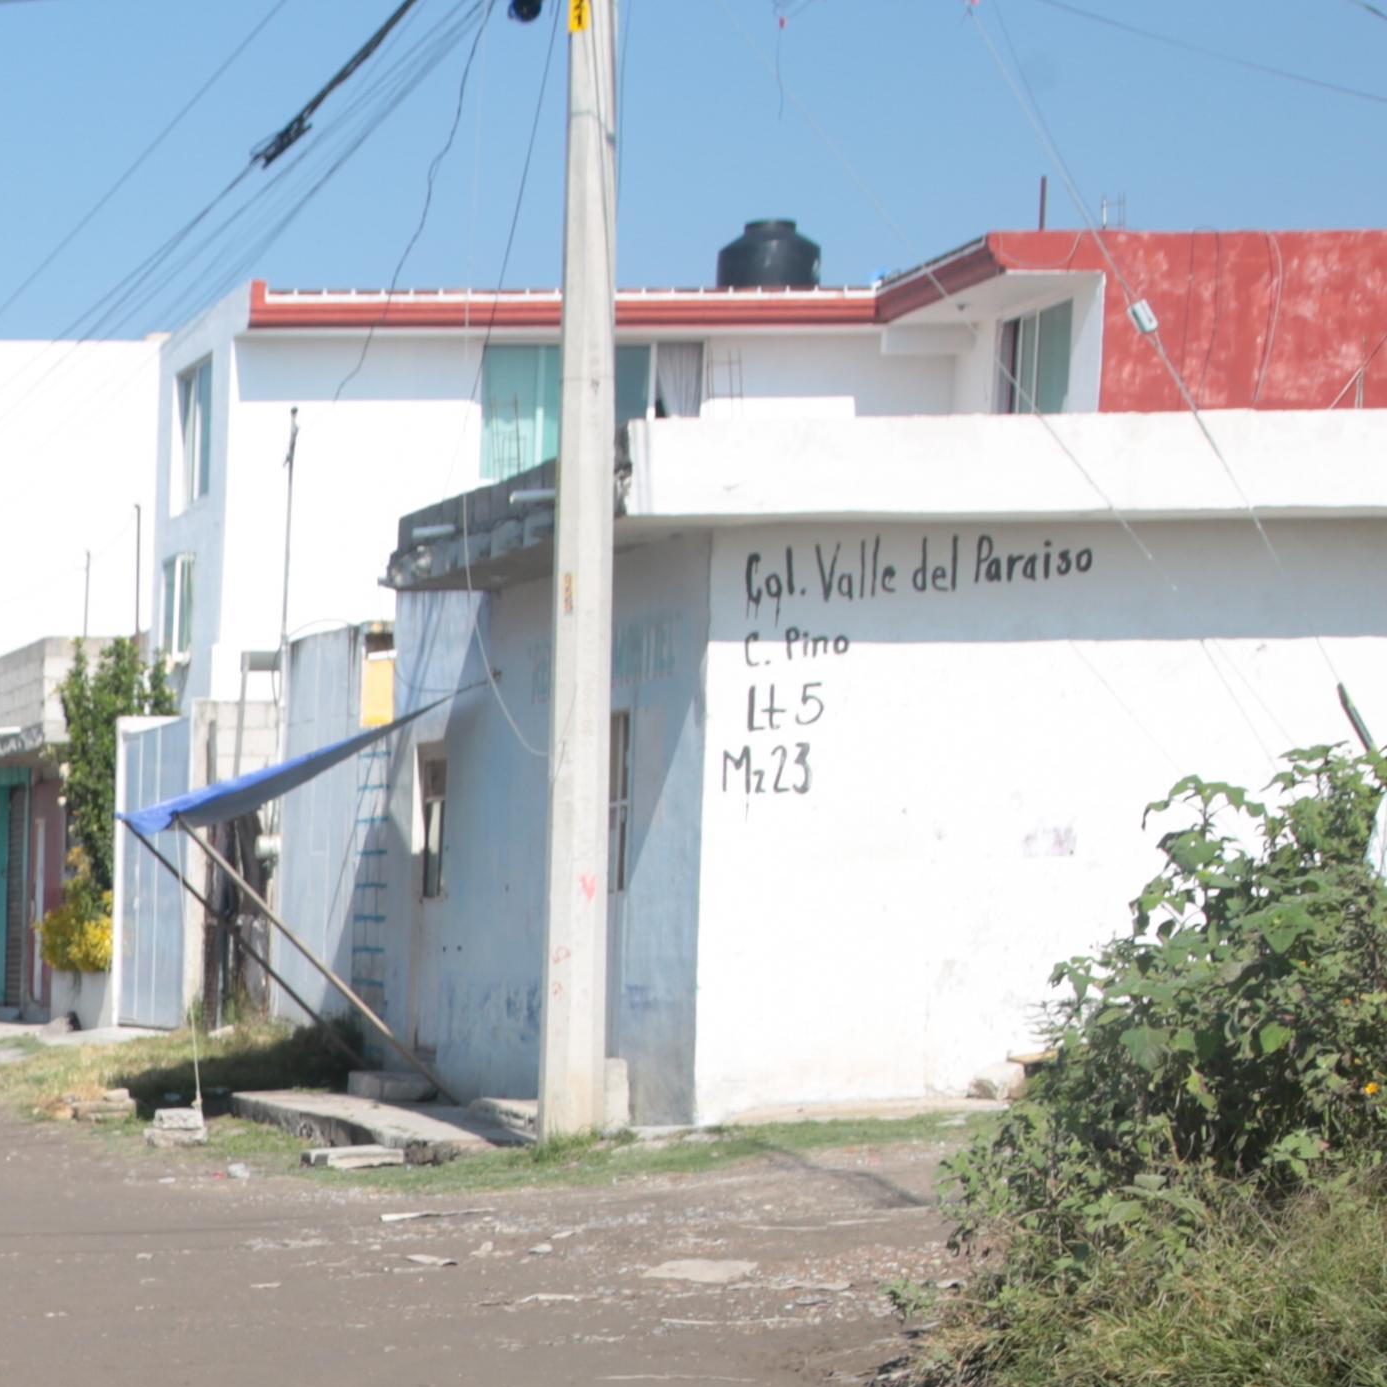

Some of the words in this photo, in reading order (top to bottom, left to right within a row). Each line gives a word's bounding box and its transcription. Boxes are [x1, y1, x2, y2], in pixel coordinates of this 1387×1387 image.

[745, 545, 806, 606] Col.
[815, 534, 896, 602] Valle
[912, 534, 959, 592] del
[974, 533, 1093, 584] Paraiso
[745, 631, 771, 667] C.
[785, 626, 849, 660] Pino
[794, 681, 824, 726] 5
